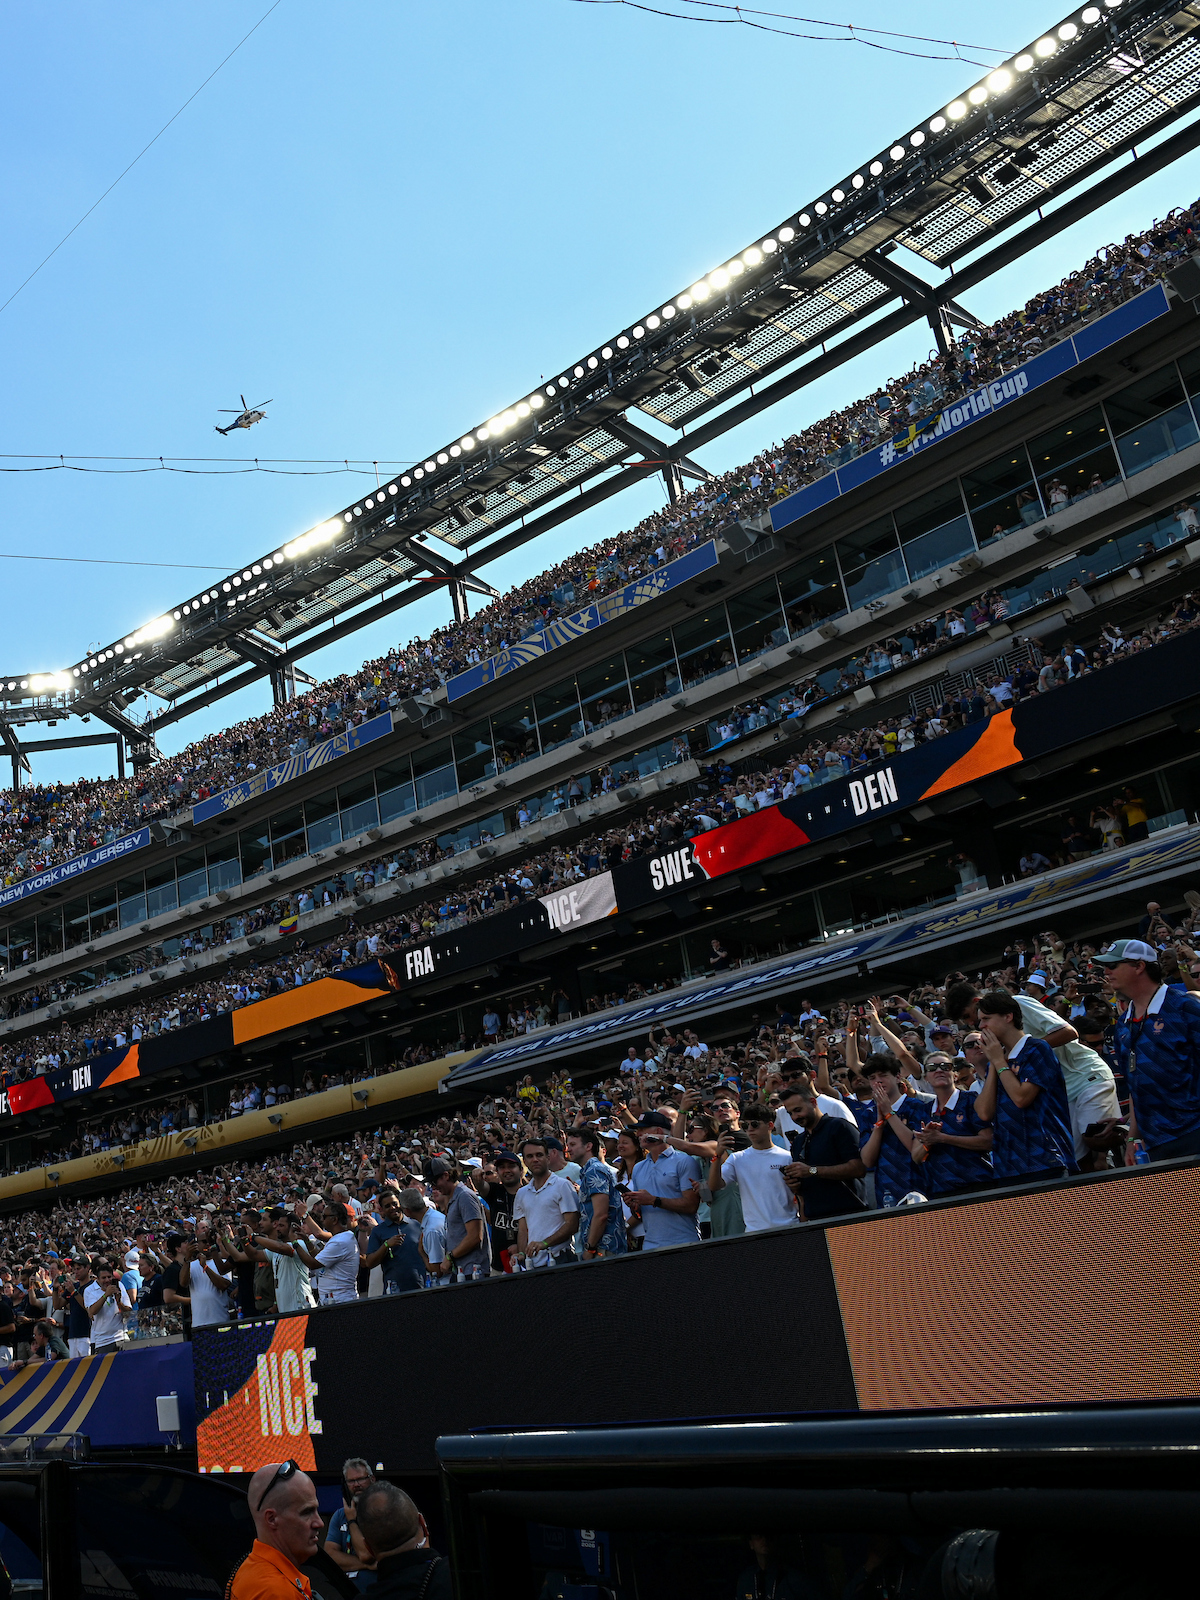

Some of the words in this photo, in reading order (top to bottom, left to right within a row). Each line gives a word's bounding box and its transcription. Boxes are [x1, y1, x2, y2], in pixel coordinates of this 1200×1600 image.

[848, 767, 899, 817] DEN
[26, 872, 59, 891] YORK
[61, 857, 89, 877] NEW
[91, 834, 142, 863] JERSEY
[649, 846, 694, 890] SWE
[546, 890, 581, 930] NCE
[405, 945, 435, 980] FRA
[482, 1040, 543, 1064] FIFA
[545, 1008, 654, 1046] WORLD
[656, 987, 726, 1013] CUP
[723, 947, 858, 994] 2026
[72, 1065, 92, 1091] DEN
[256, 1346, 323, 1437] NCE
